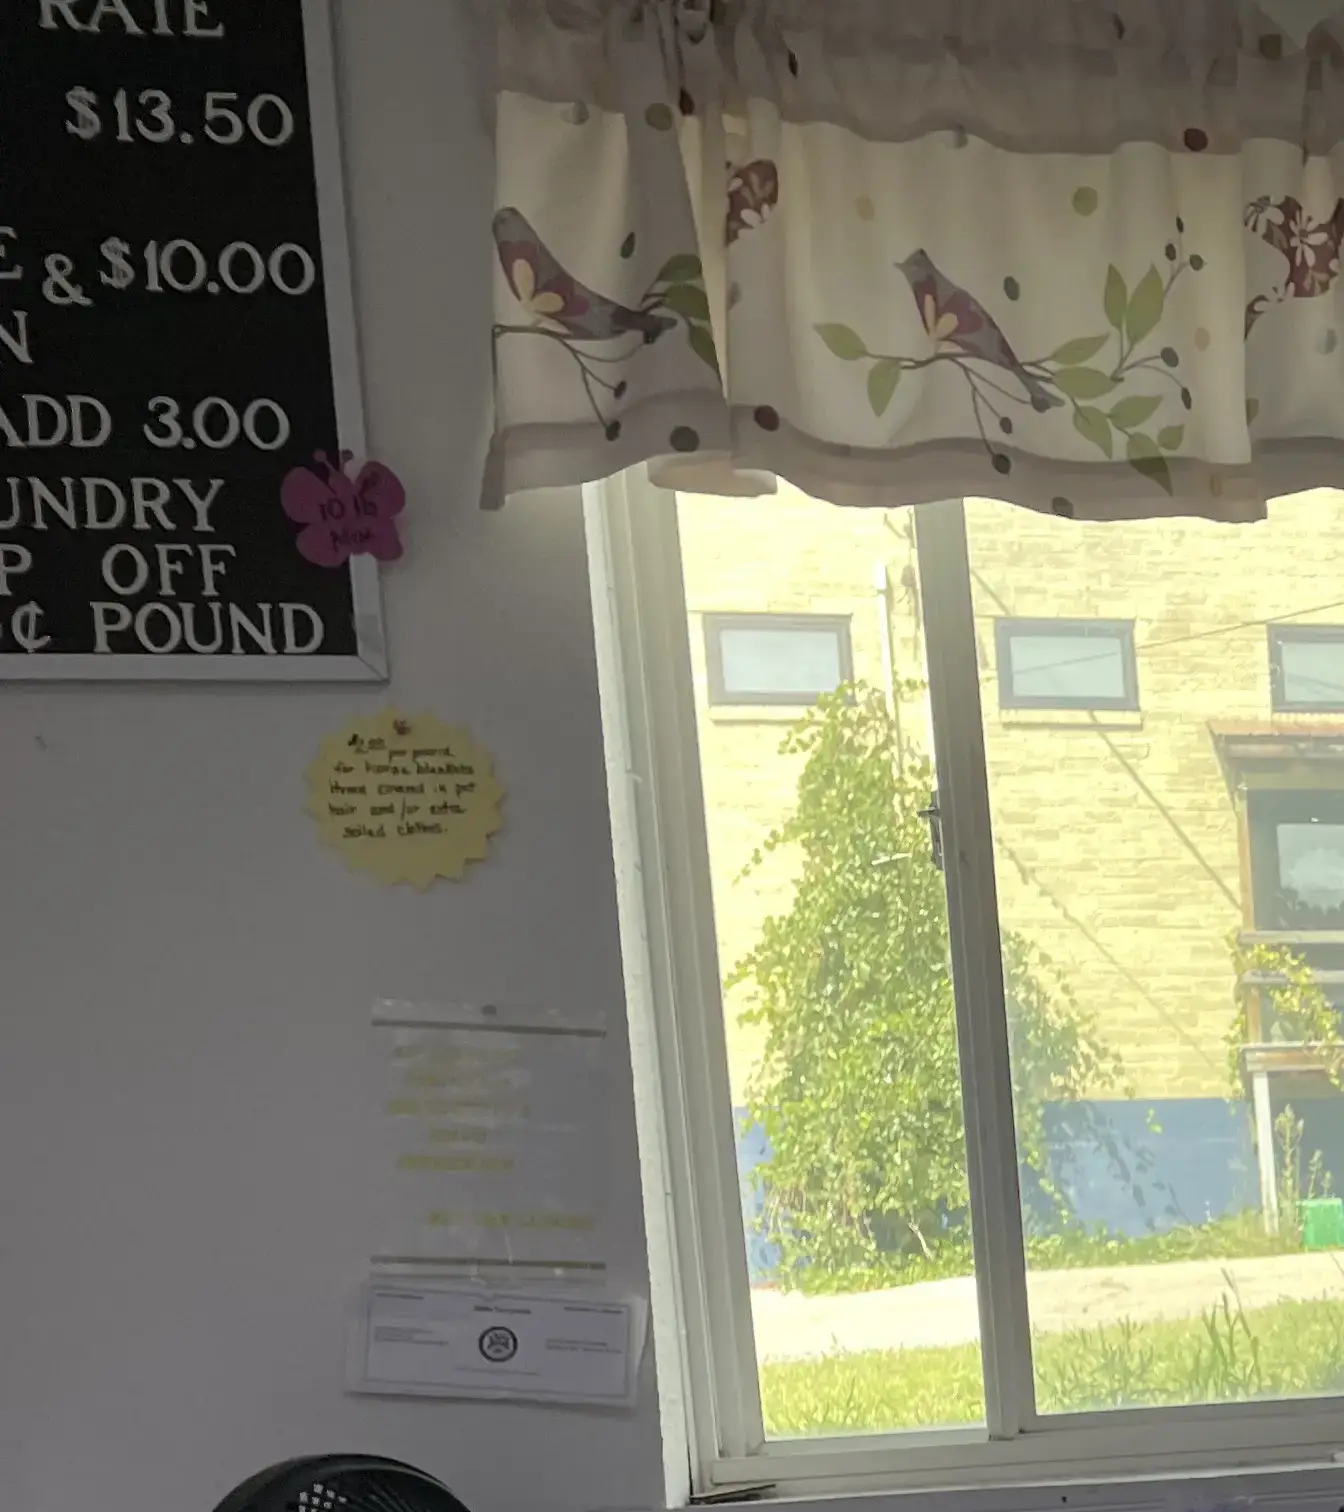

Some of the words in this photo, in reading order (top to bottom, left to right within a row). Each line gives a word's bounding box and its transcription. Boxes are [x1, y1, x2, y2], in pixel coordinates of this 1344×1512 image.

[64, 86, 295, 147] $13.50
[41, 253, 93, 306] &
[99, 237, 316, 295] $10.00
[143, 395, 290, 450] 3.00
[101, 543, 237, 597] OFF
[88, 601, 325, 654] POUND
